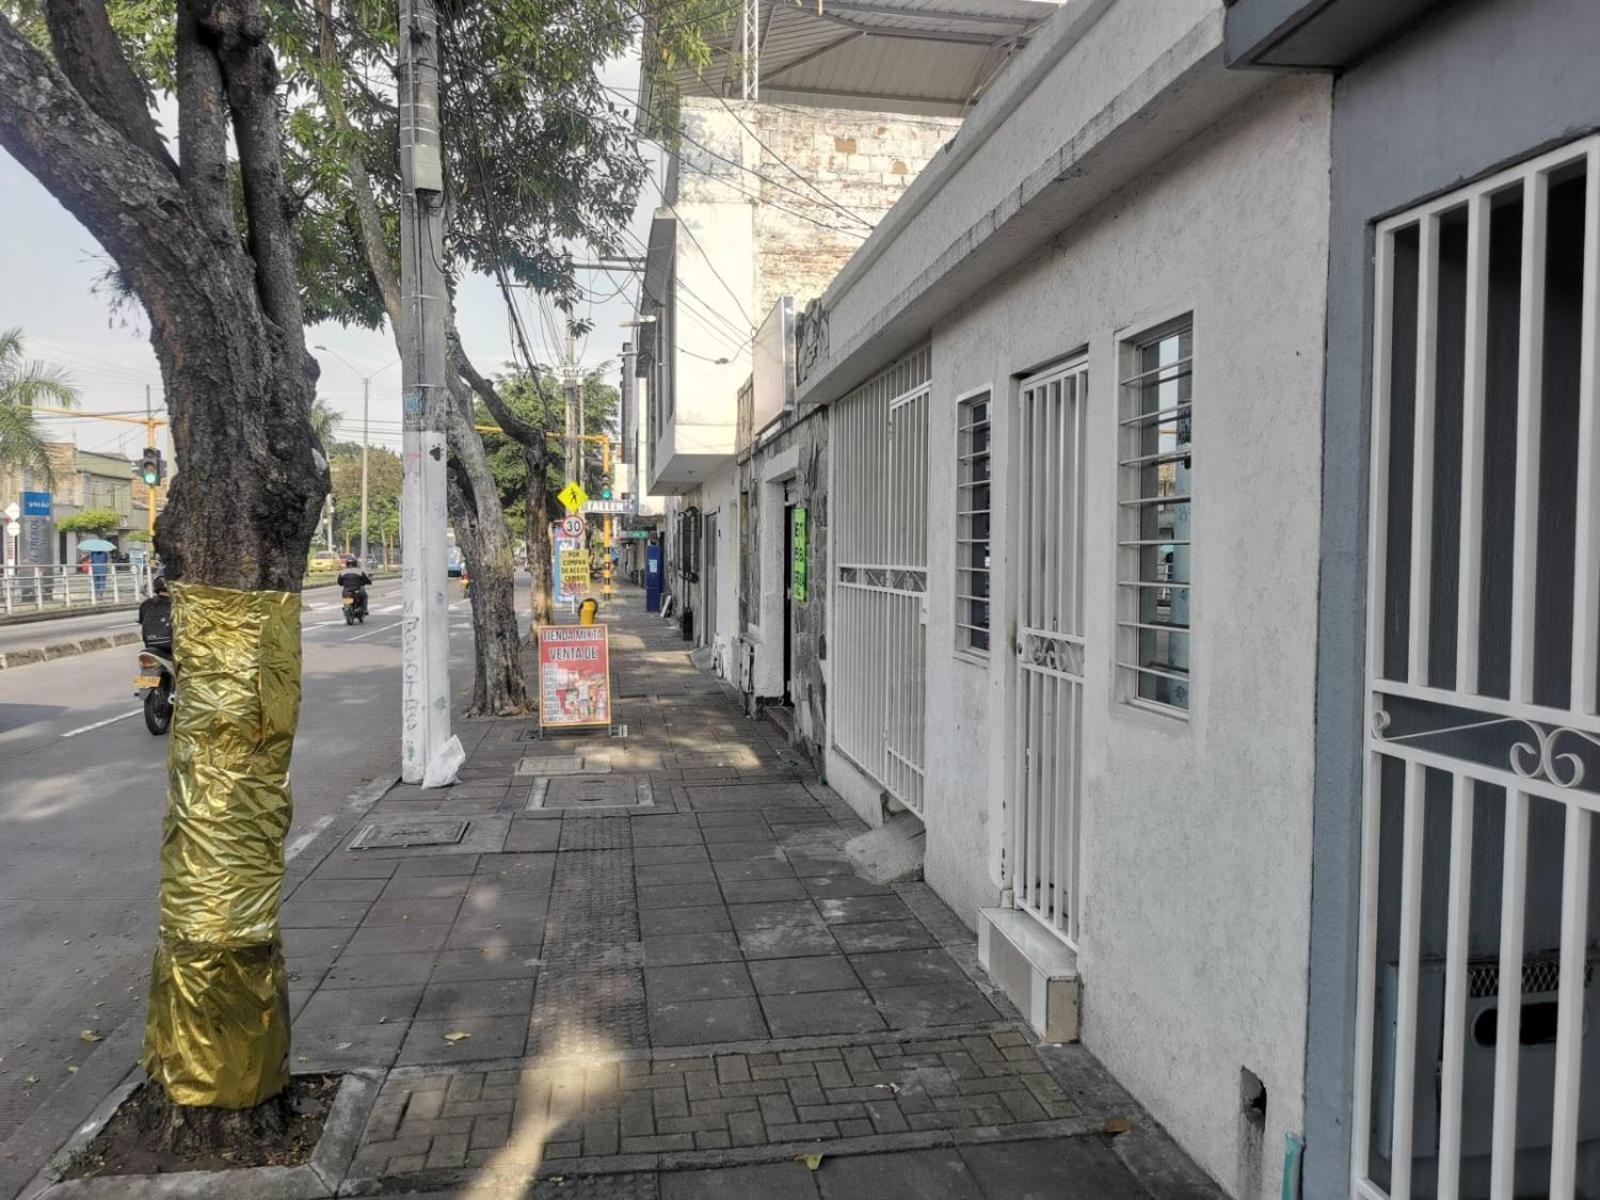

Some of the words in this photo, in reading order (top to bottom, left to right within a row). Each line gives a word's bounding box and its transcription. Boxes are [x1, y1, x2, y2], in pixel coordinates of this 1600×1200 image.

[566, 520, 581, 532] 30
[543, 629, 575, 641] TIENDA
[549, 647, 582, 660] VENTA
[584, 646, 598, 659] DE
